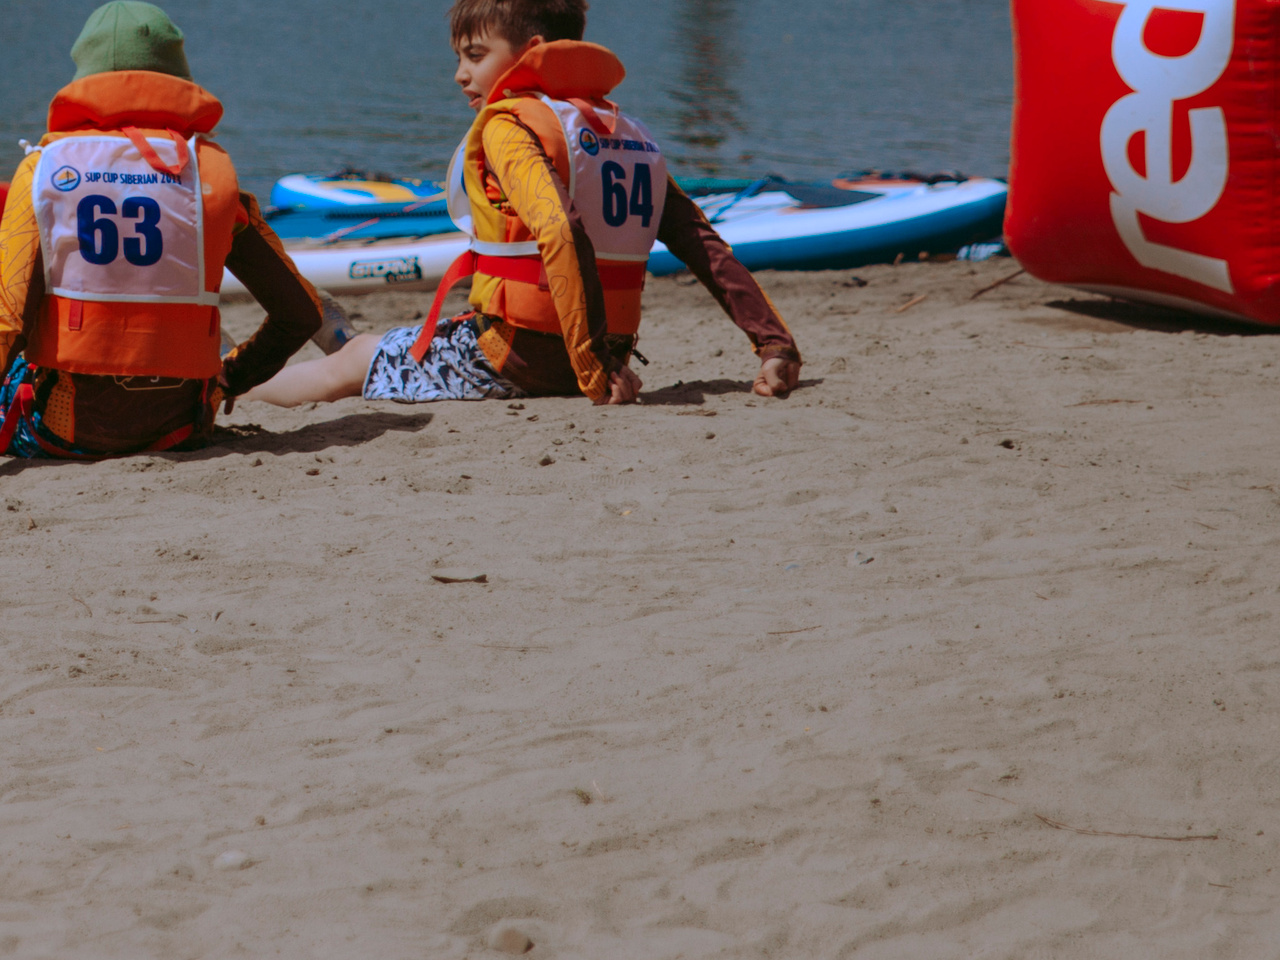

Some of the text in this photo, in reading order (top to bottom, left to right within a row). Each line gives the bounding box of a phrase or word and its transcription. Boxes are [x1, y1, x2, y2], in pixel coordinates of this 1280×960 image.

[85, 172, 101, 182] SUP
[102, 172, 119, 183] CUP
[119, 173, 158, 185] SIBERIAN
[601, 160, 653, 228] 64
[77, 194, 163, 266] 63
